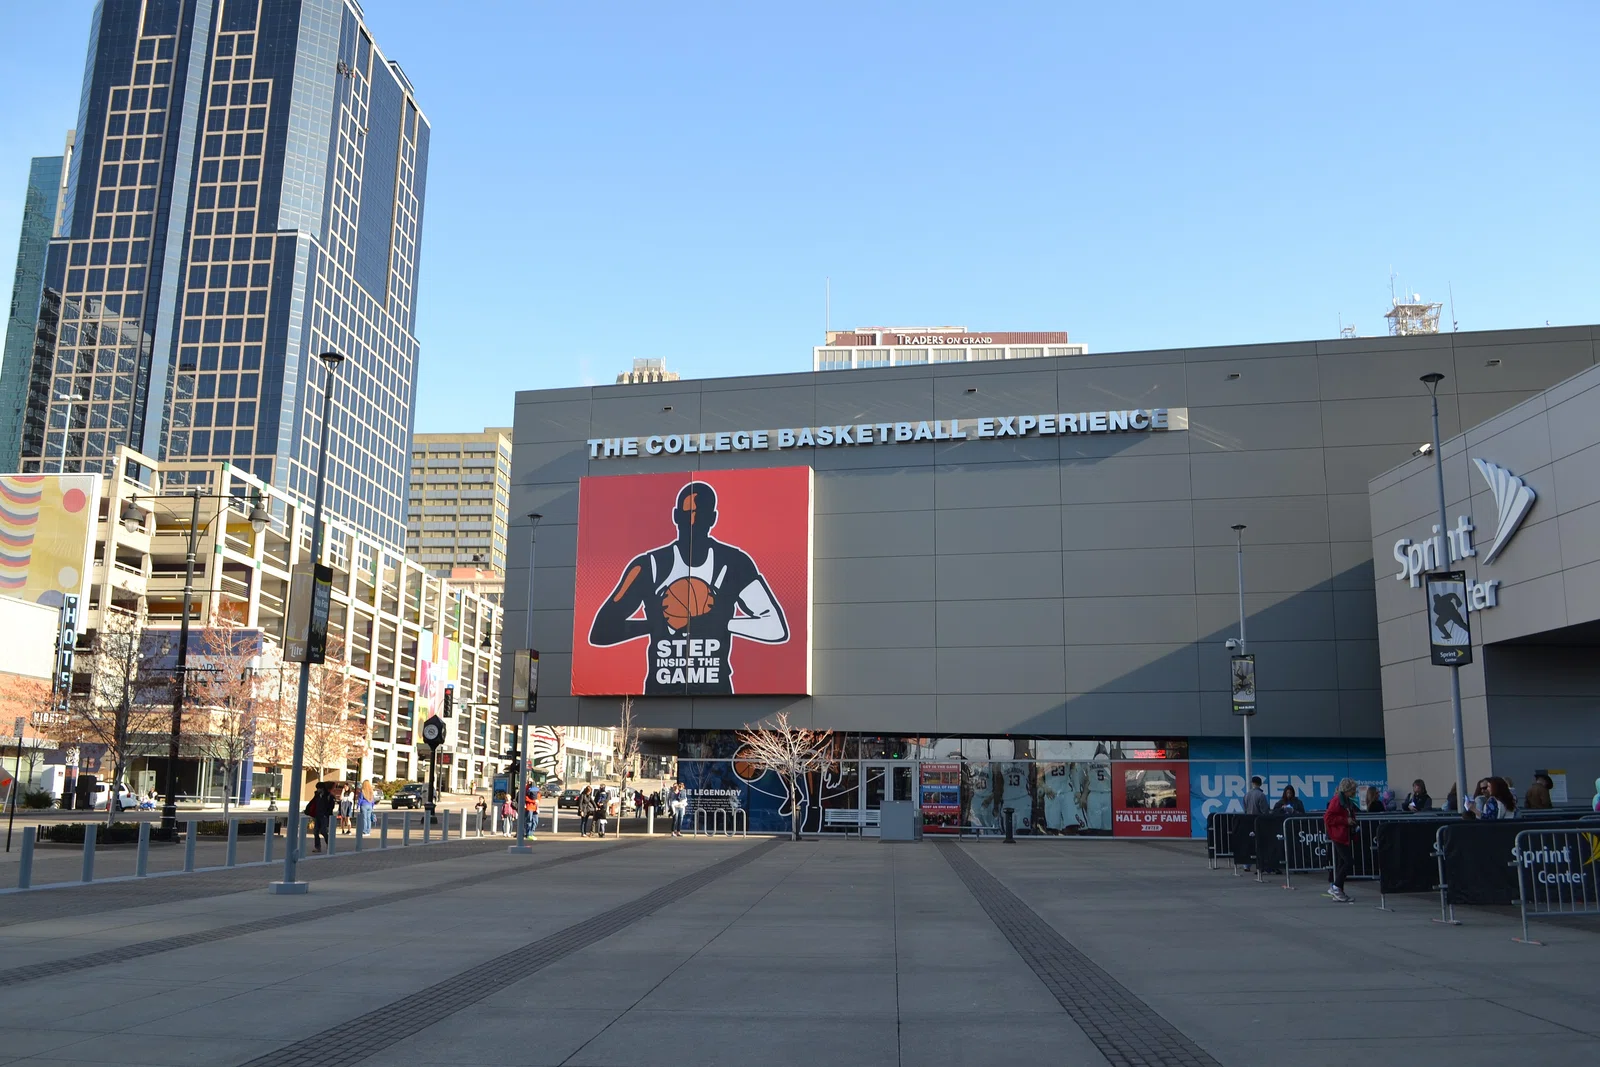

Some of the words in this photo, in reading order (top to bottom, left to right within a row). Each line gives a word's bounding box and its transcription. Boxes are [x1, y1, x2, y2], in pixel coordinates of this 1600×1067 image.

[897, 334, 944, 344] TRADERS
[587, 437, 638, 457] THE
[645, 430, 769, 455] COLLEGE
[777, 419, 967, 448] BASKETBALL
[977, 408, 1169, 438] EXPERIENCE
[1393, 515, 1476, 588] Sprint
[1466, 578, 1500, 612] ter
[656, 638, 720, 658] STEP
[59, 607, 76, 710] HOTEL
[656, 658, 694, 667] INSIDE
[698, 657, 720, 666] THE
[656, 667, 720, 684] GAME
[1051, 766, 1066, 776] 23
[1097, 770, 1104, 782] 5
[1008, 774, 1020, 786] 13
[1200, 775, 1334, 798] URGENT
[1298, 830, 1328, 846] Sprin
[1511, 846, 1571, 868] Sprint
[1538, 870, 1586, 884] Center
